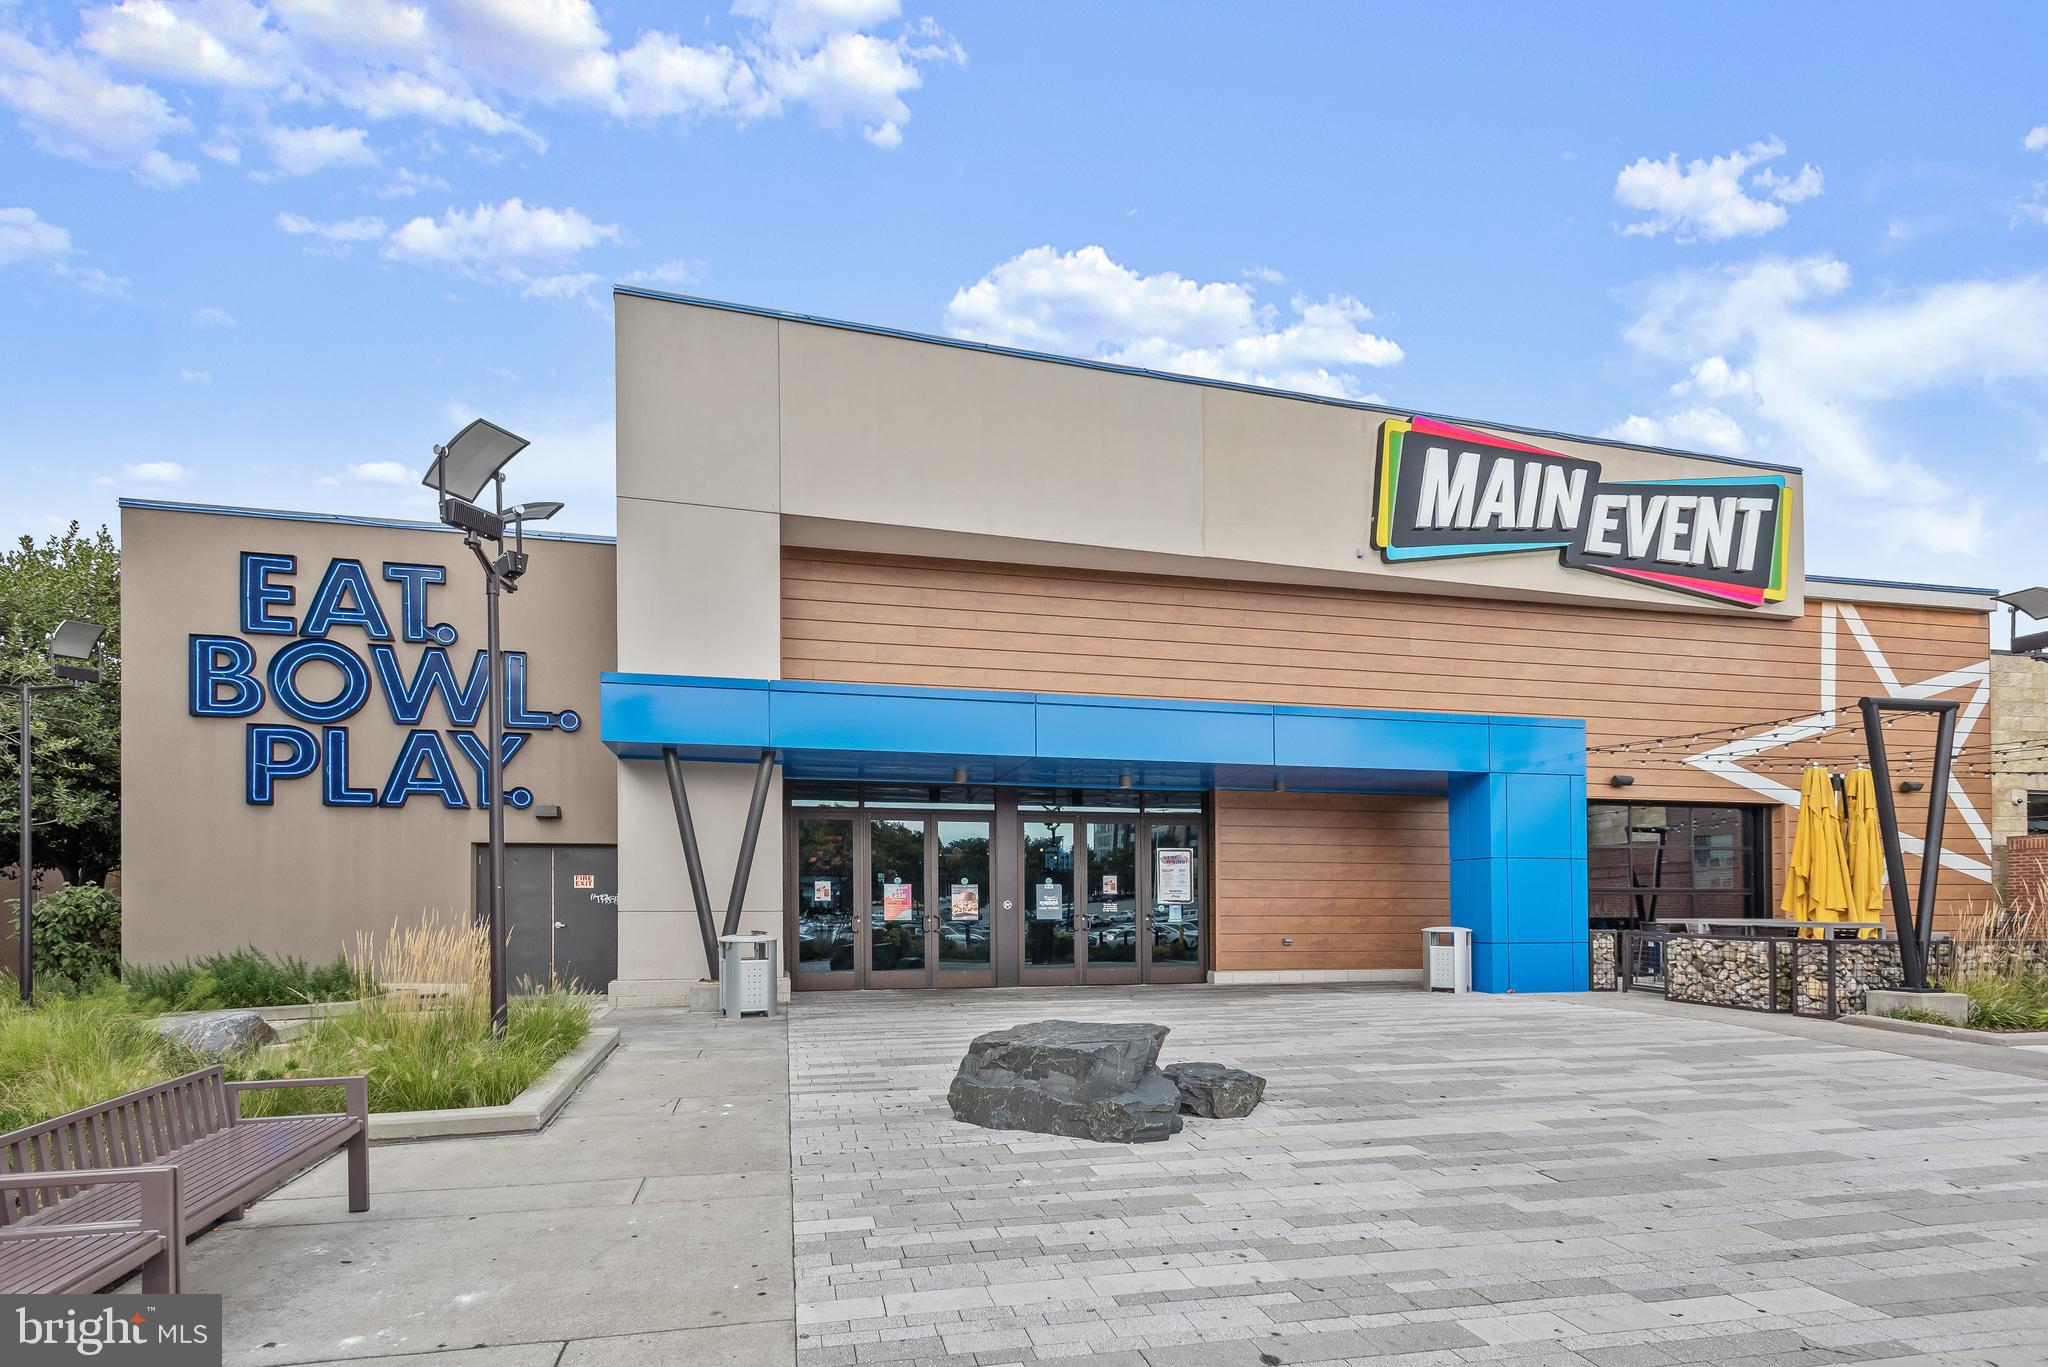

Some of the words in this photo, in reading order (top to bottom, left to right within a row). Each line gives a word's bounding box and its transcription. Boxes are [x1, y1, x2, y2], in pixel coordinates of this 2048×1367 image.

[1413, 447, 1587, 530] MAIN
[1584, 494, 1774, 572] EVENT
[240, 551, 458, 646] EAT.
[189, 633, 582, 732] BOWL.
[246, 723, 534, 810] PLAY.
